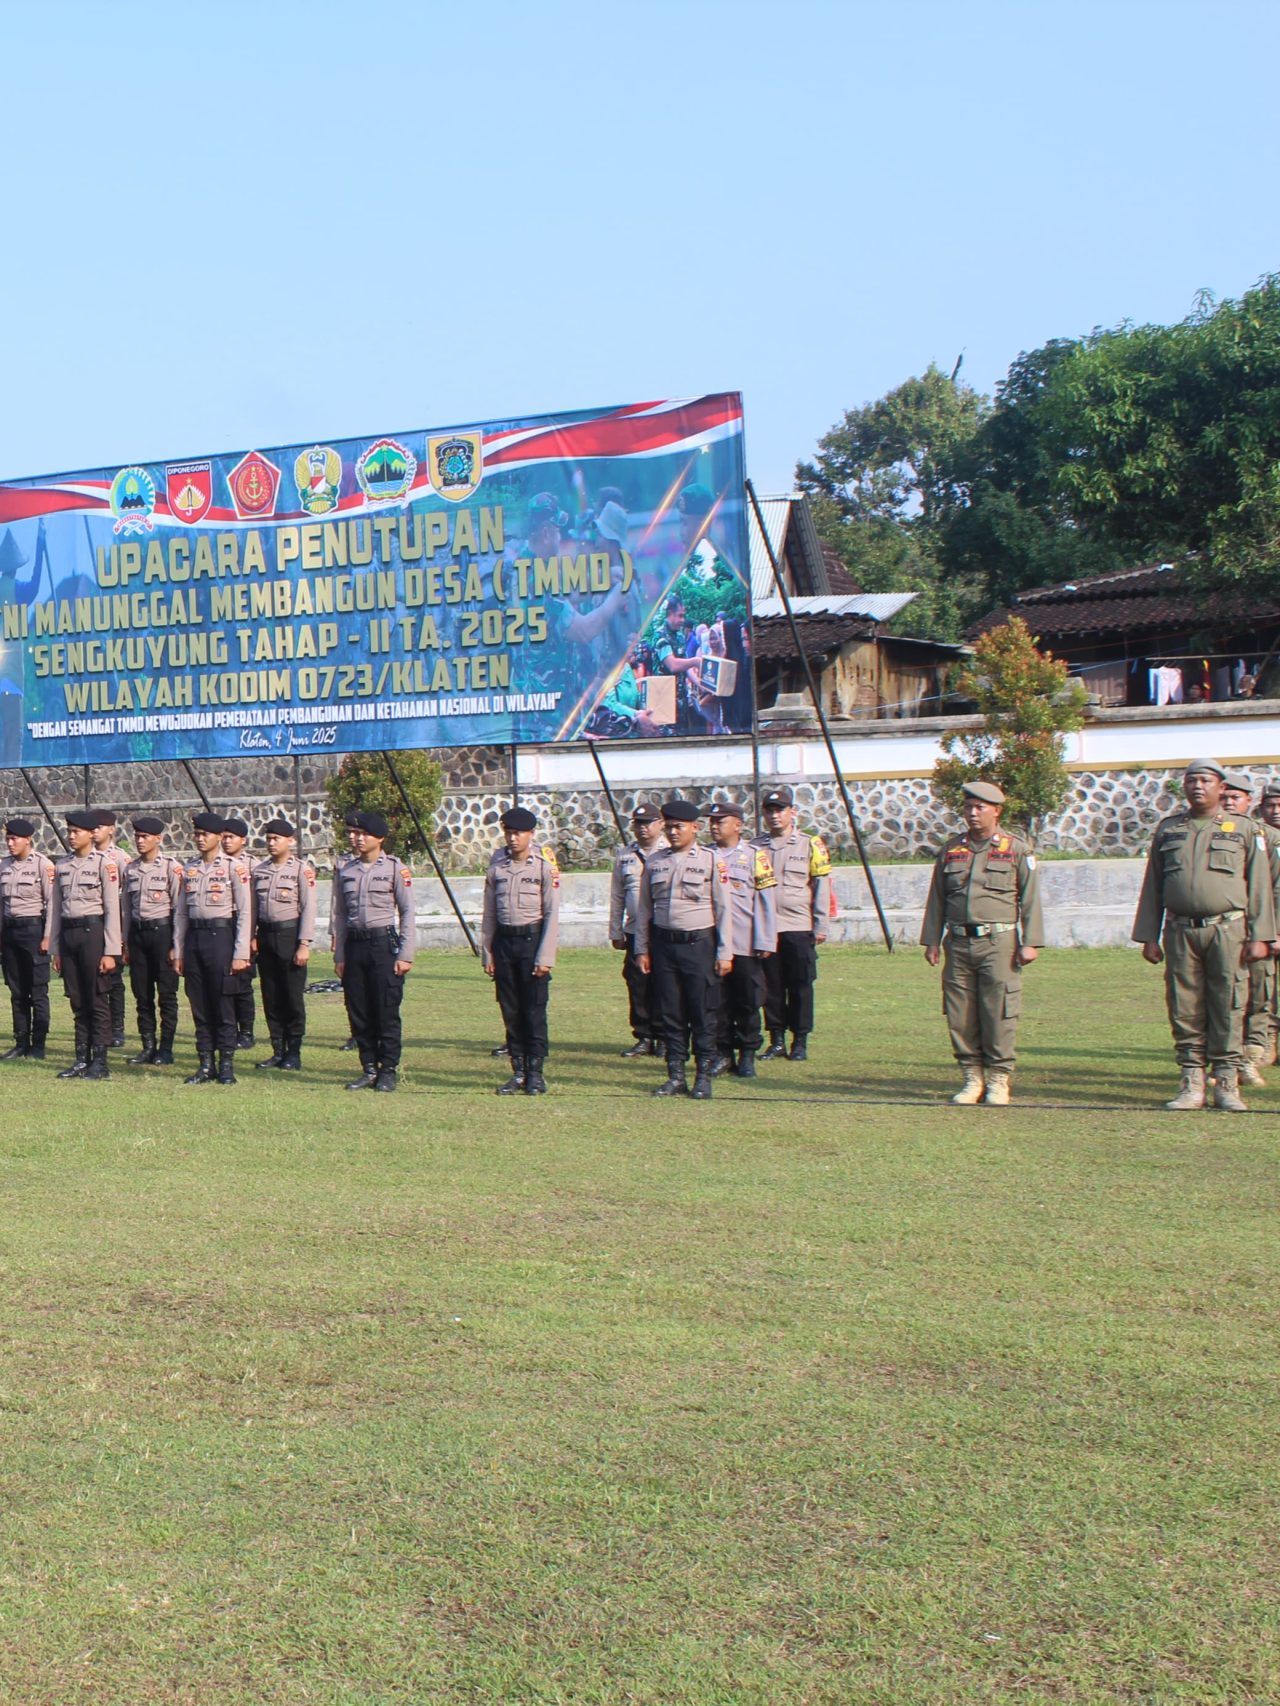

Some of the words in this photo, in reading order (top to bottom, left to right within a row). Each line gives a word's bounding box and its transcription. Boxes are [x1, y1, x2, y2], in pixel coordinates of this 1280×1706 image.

[168, 464, 209, 475] DIPONEGORO
[97, 530, 266, 588] UPACARA
[277, 506, 505, 572] PENUTUPAN
[35, 588, 203, 637] MANUNGGAL
[210, 571, 396, 623] MEMBANGUN
[404, 563, 484, 607] DESA
[34, 632, 228, 677] SENGKUYUNG
[236, 622, 338, 663] TAHAP
[370, 618, 390, 654] II
[400, 615, 452, 652] TA.
[461, 606, 548, 647] 2025
[64, 676, 192, 713] WILAYAH
[199, 668, 291, 705] KODIM
[298, 654, 509, 700] 0723/KLATEN
[68, 718, 115, 737] SEMANGAT
[117, 716, 144, 733] TMMD
[145, 712, 213, 732] MEWUJUDKAN
[215, 709, 274, 728] PEMERATAAN
[278, 704, 352, 725] PEMBANGUNAN
[354, 703, 375, 721] DAN
[377, 699, 437, 720] KETAHANAN
[439, 696, 491, 716] NASIONAL
[493, 695, 504, 713] DI
[275, 731, 282, 747] 4
[286, 727, 309, 753] Juni
[311, 726, 337, 745] 2025
